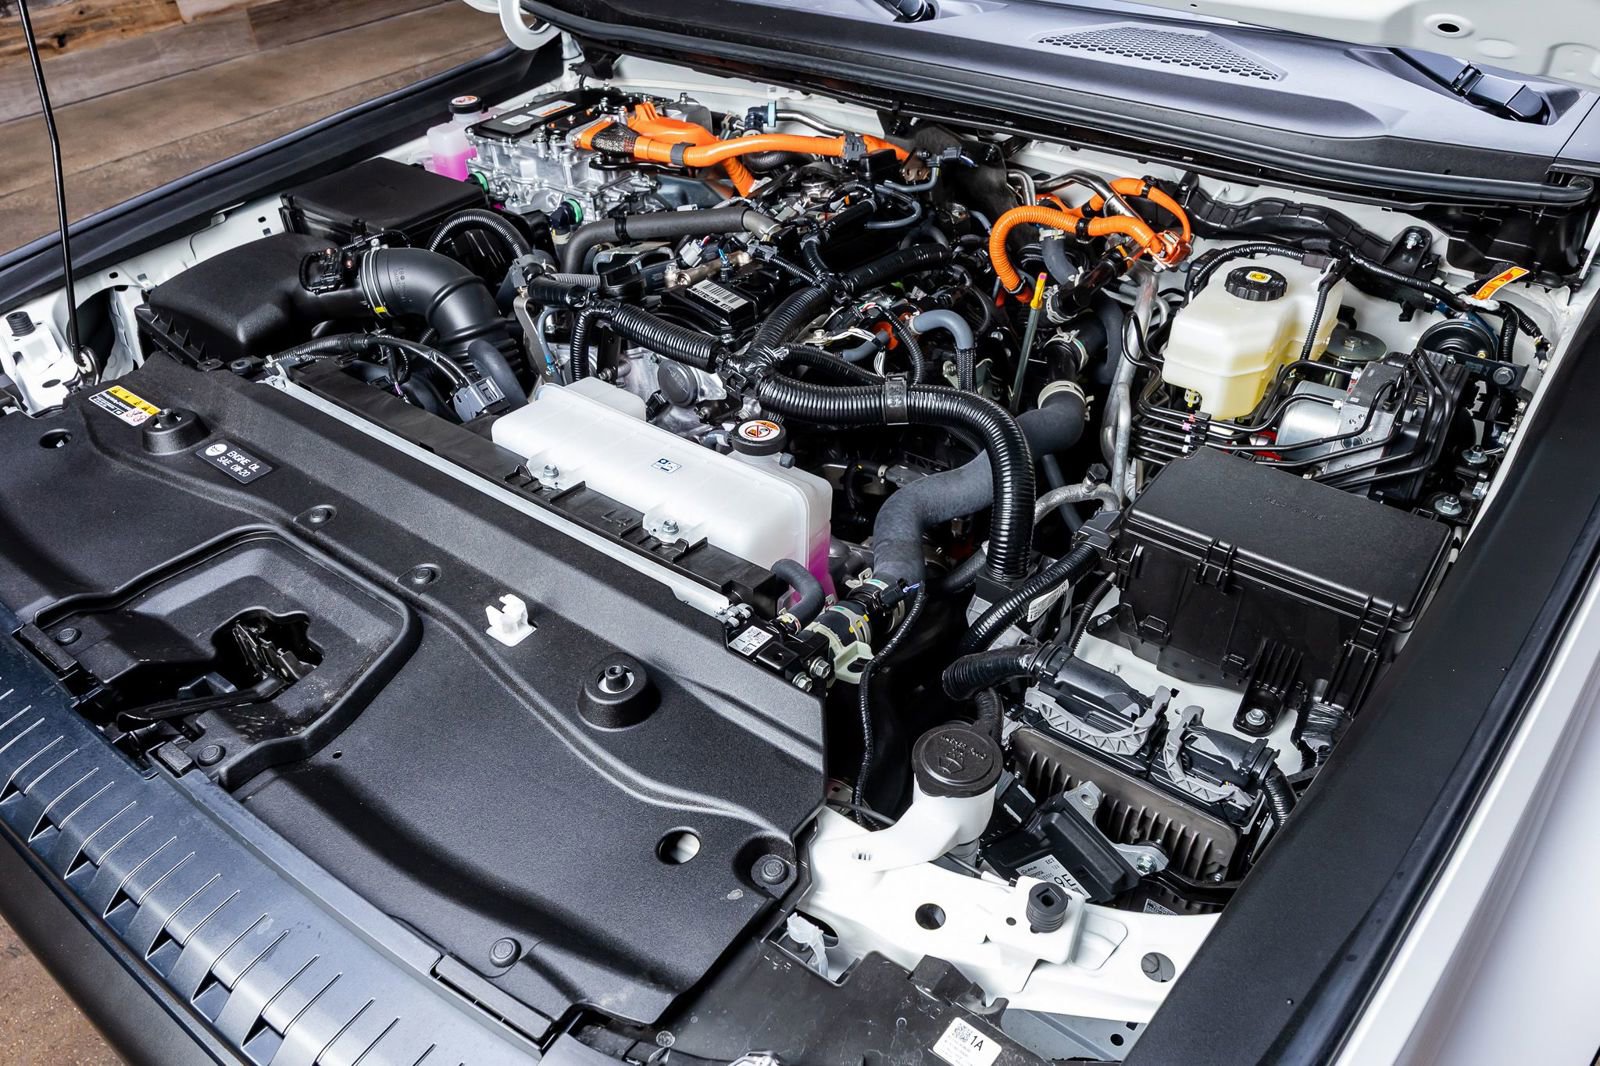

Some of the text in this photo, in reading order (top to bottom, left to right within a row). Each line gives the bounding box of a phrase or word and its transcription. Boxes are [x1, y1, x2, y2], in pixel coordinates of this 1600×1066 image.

[217, 456, 233, 466] SAE
[227, 450, 251, 465] ENGINE
[248, 463, 260, 472] OIL
[970, 1035, 984, 1052] 1A
